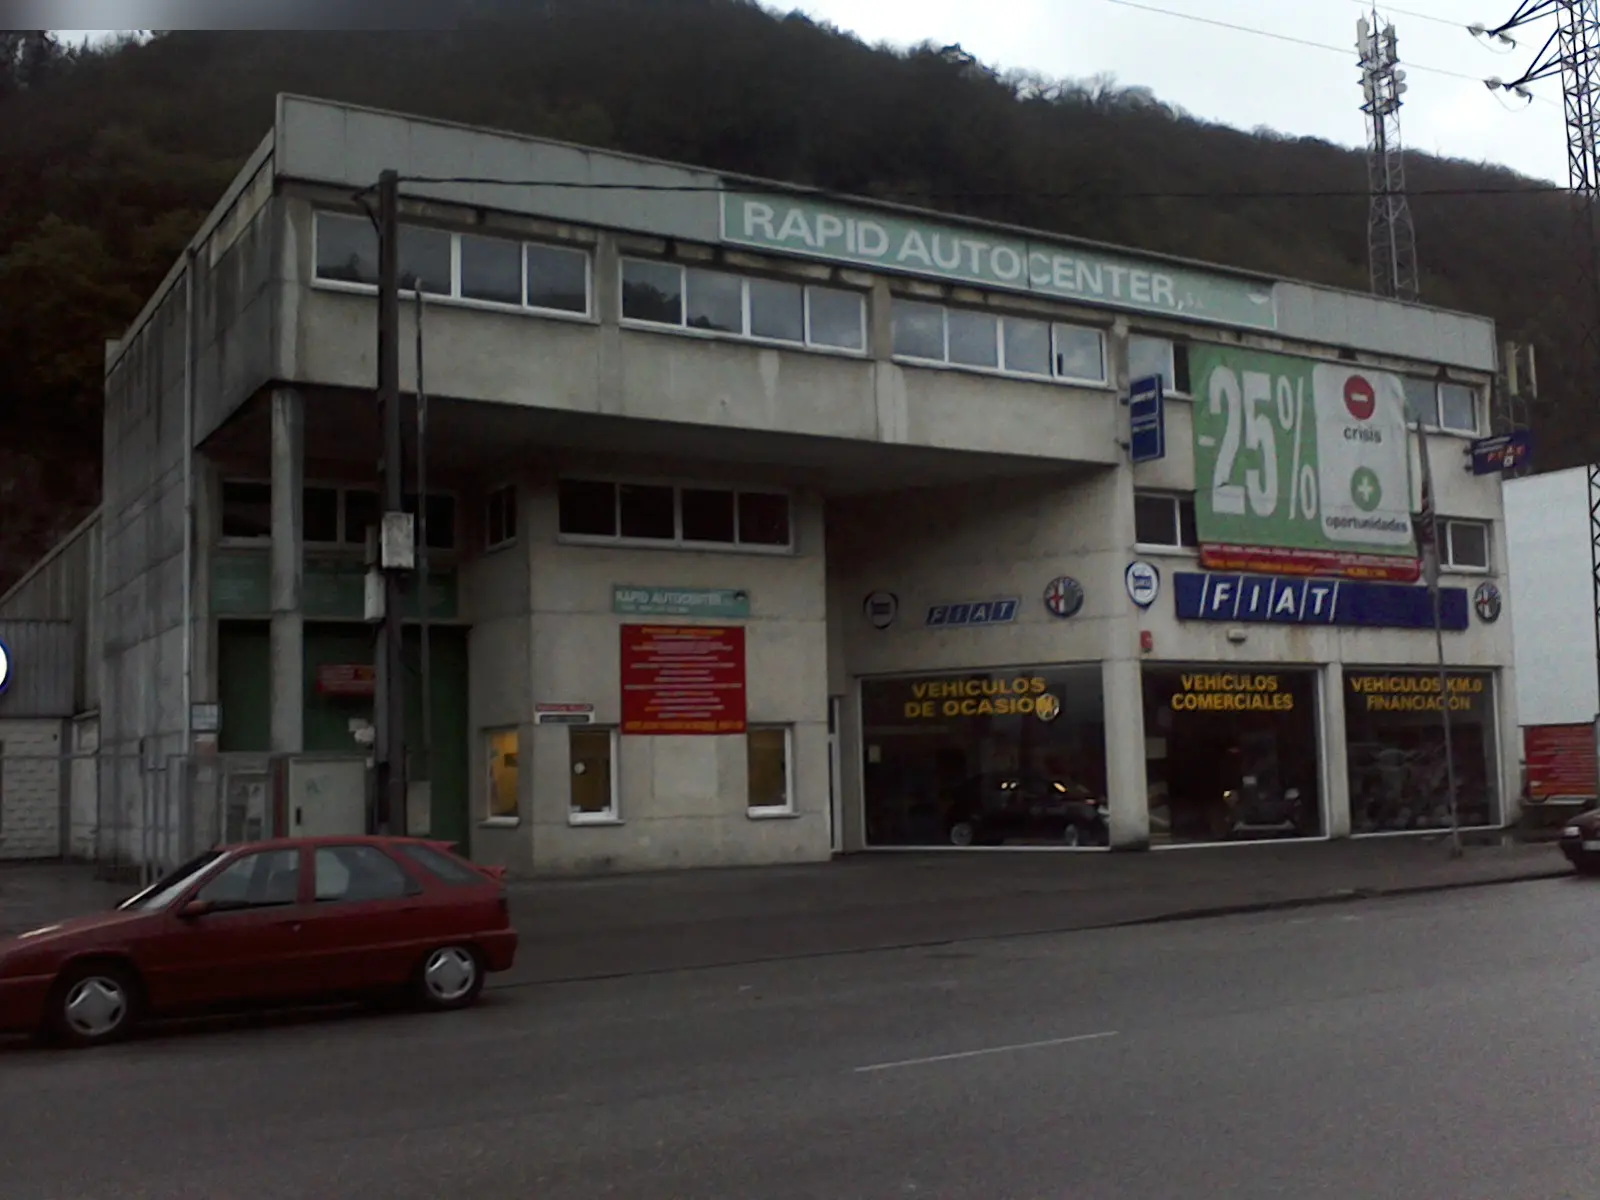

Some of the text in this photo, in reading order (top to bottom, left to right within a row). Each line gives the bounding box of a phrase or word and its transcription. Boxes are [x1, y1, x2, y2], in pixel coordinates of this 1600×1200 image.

[744, 201, 890, 257] RAPID
[1198, 365, 1321, 520] -25%
[1343, 426, 1382, 443] crisis
[1325, 515, 1408, 533] oportunidades
[1212, 582, 1329, 615] FIAT
[929, 601, 1012, 623] FIAT
[911, 677, 1046, 698] VEHICULOS
[1182, 674, 1278, 691] VEHICULOS
[1350, 676, 1443, 692] VEHICULOS
[905, 702, 935, 718] DE
[1172, 693, 1294, 710] COMERCIALES
